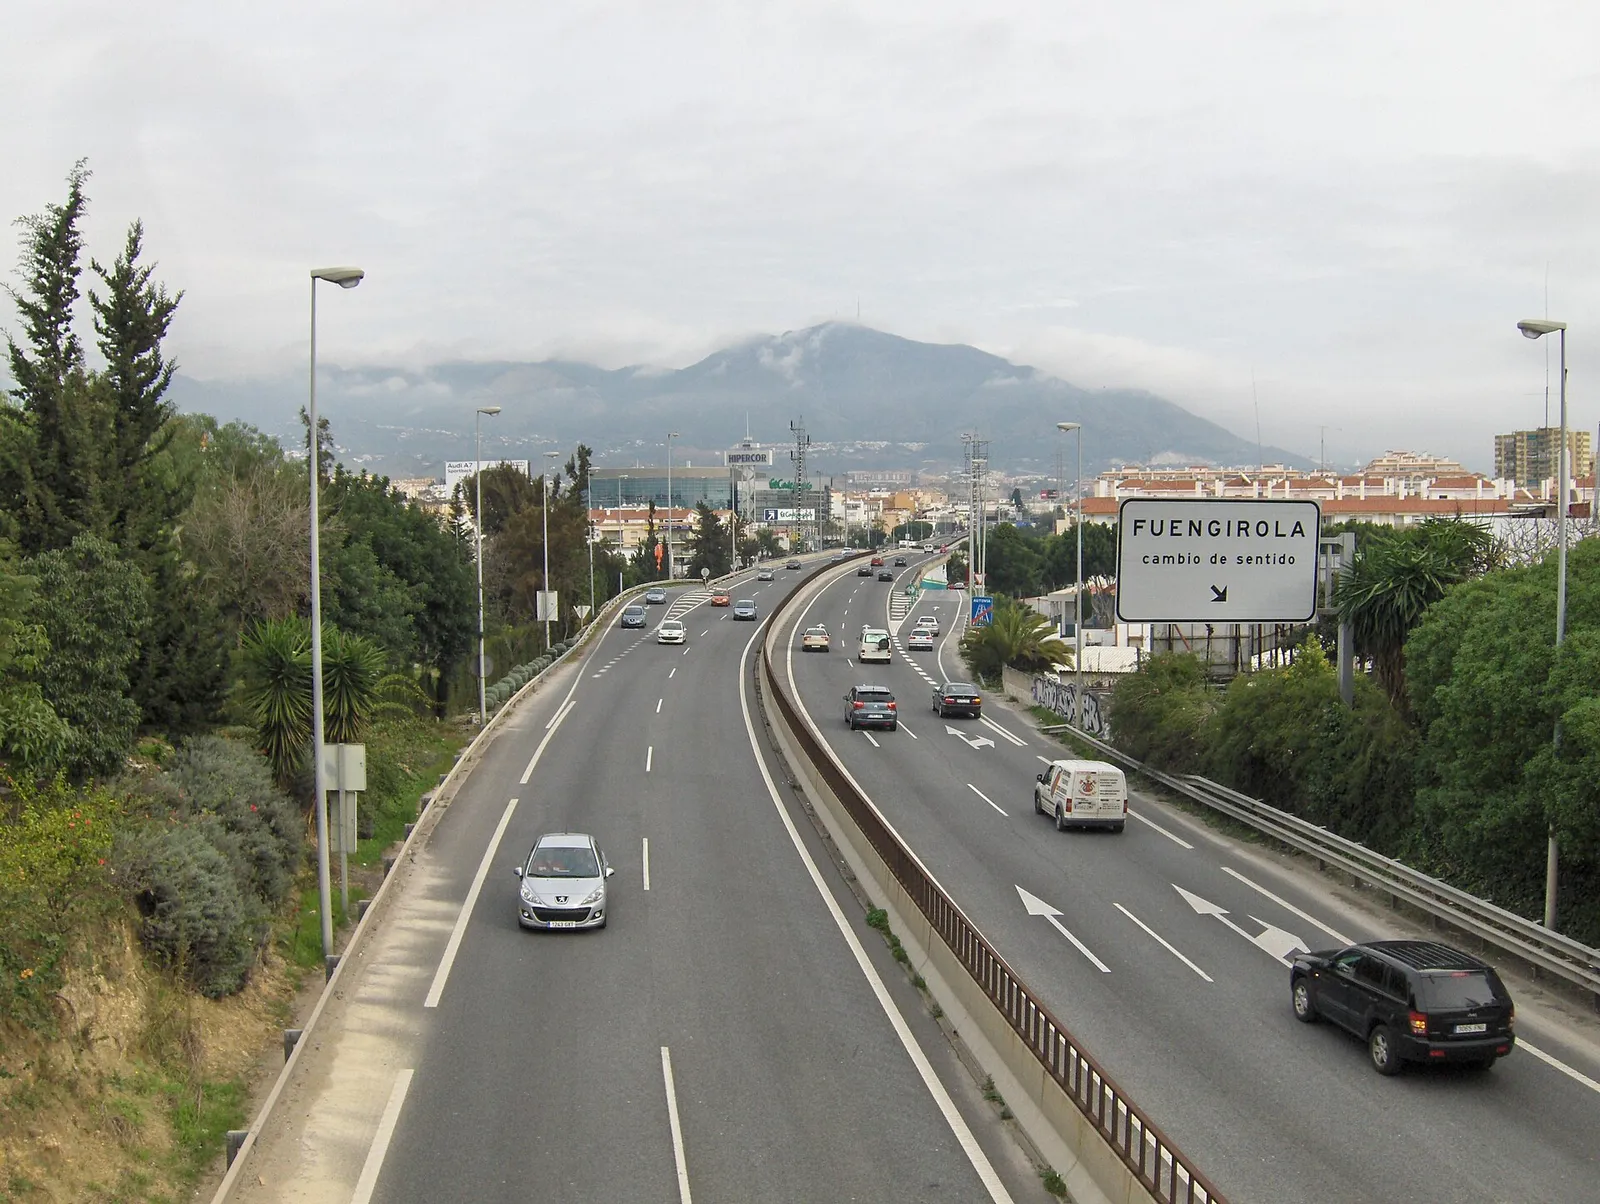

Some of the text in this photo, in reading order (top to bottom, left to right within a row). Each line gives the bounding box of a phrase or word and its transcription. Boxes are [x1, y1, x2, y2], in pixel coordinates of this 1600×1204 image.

[728, 454, 767, 463] HIPERCOR
[1133, 519, 1306, 538] FUENGIROLA
[1142, 552, 1296, 565] cambio de sentido
